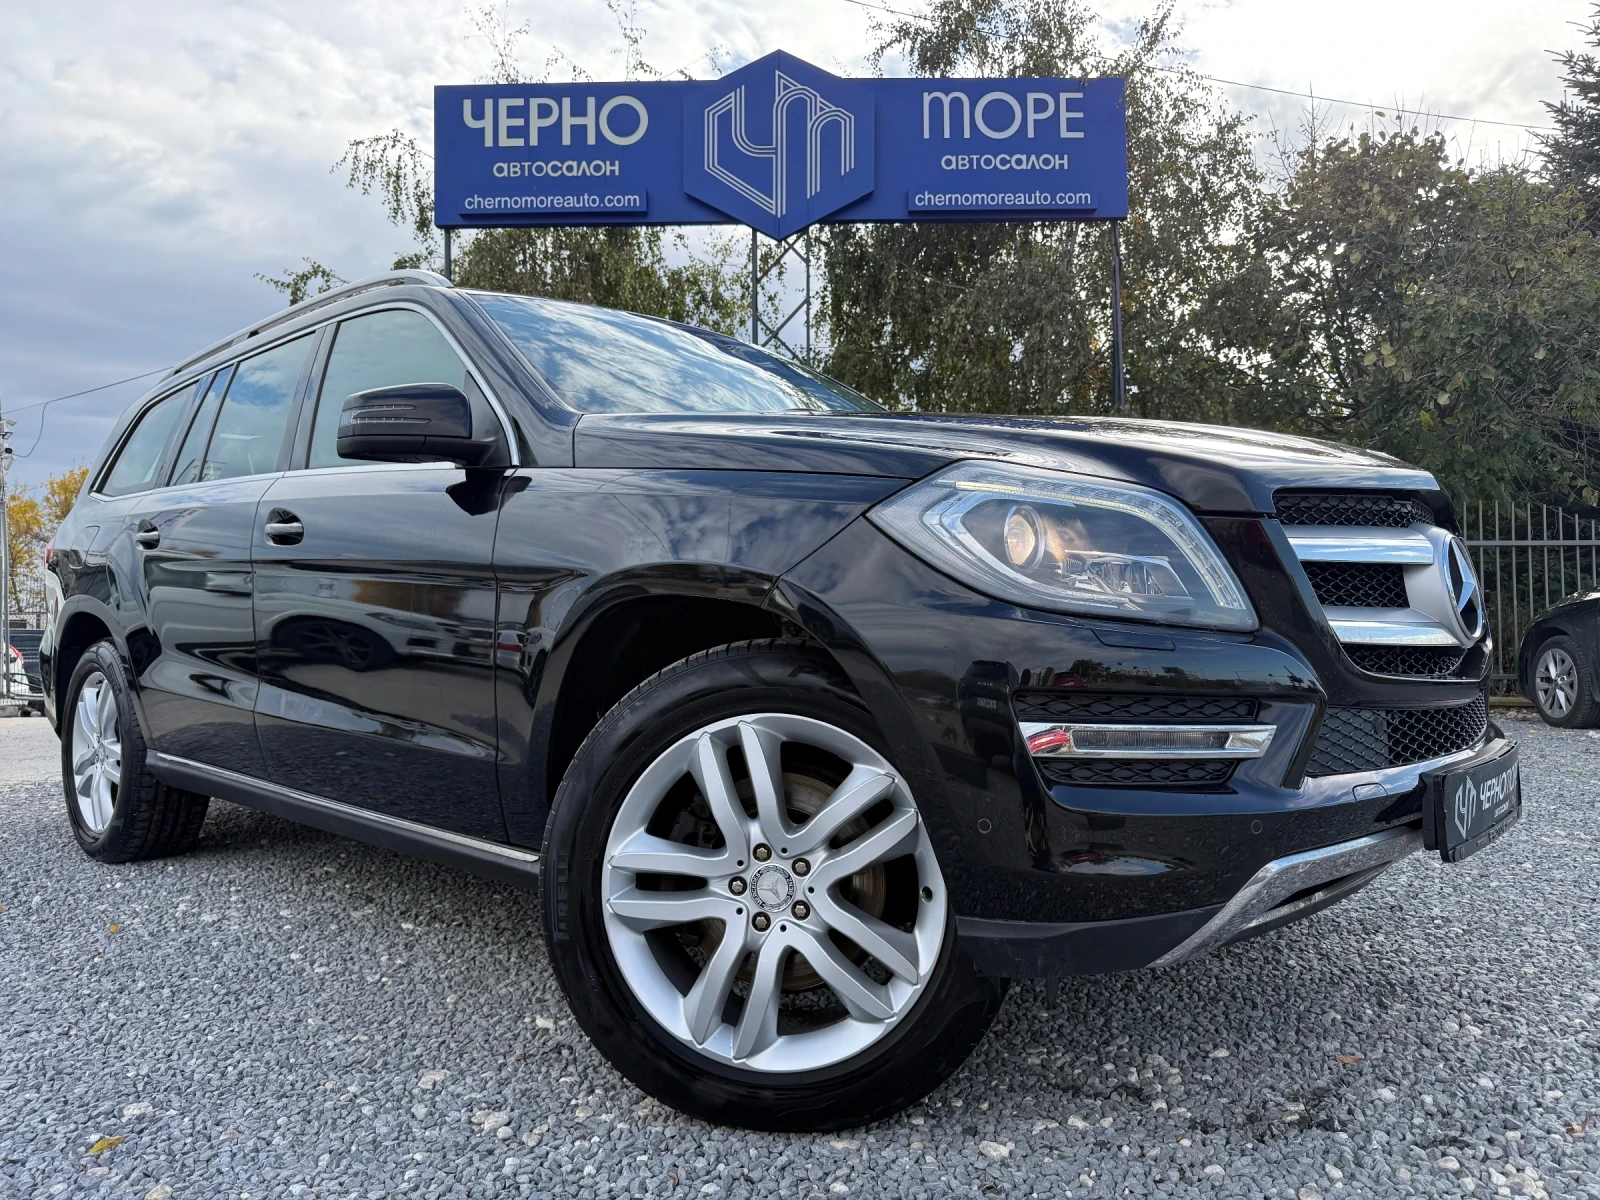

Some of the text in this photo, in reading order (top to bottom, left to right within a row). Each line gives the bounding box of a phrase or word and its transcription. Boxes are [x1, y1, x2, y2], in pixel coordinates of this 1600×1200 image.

[463, 95, 649, 147] ЧЕРНО
[464, 192, 640, 210] chernomoreauto.com
[914, 190, 1091, 207] chernomoreauto.com
